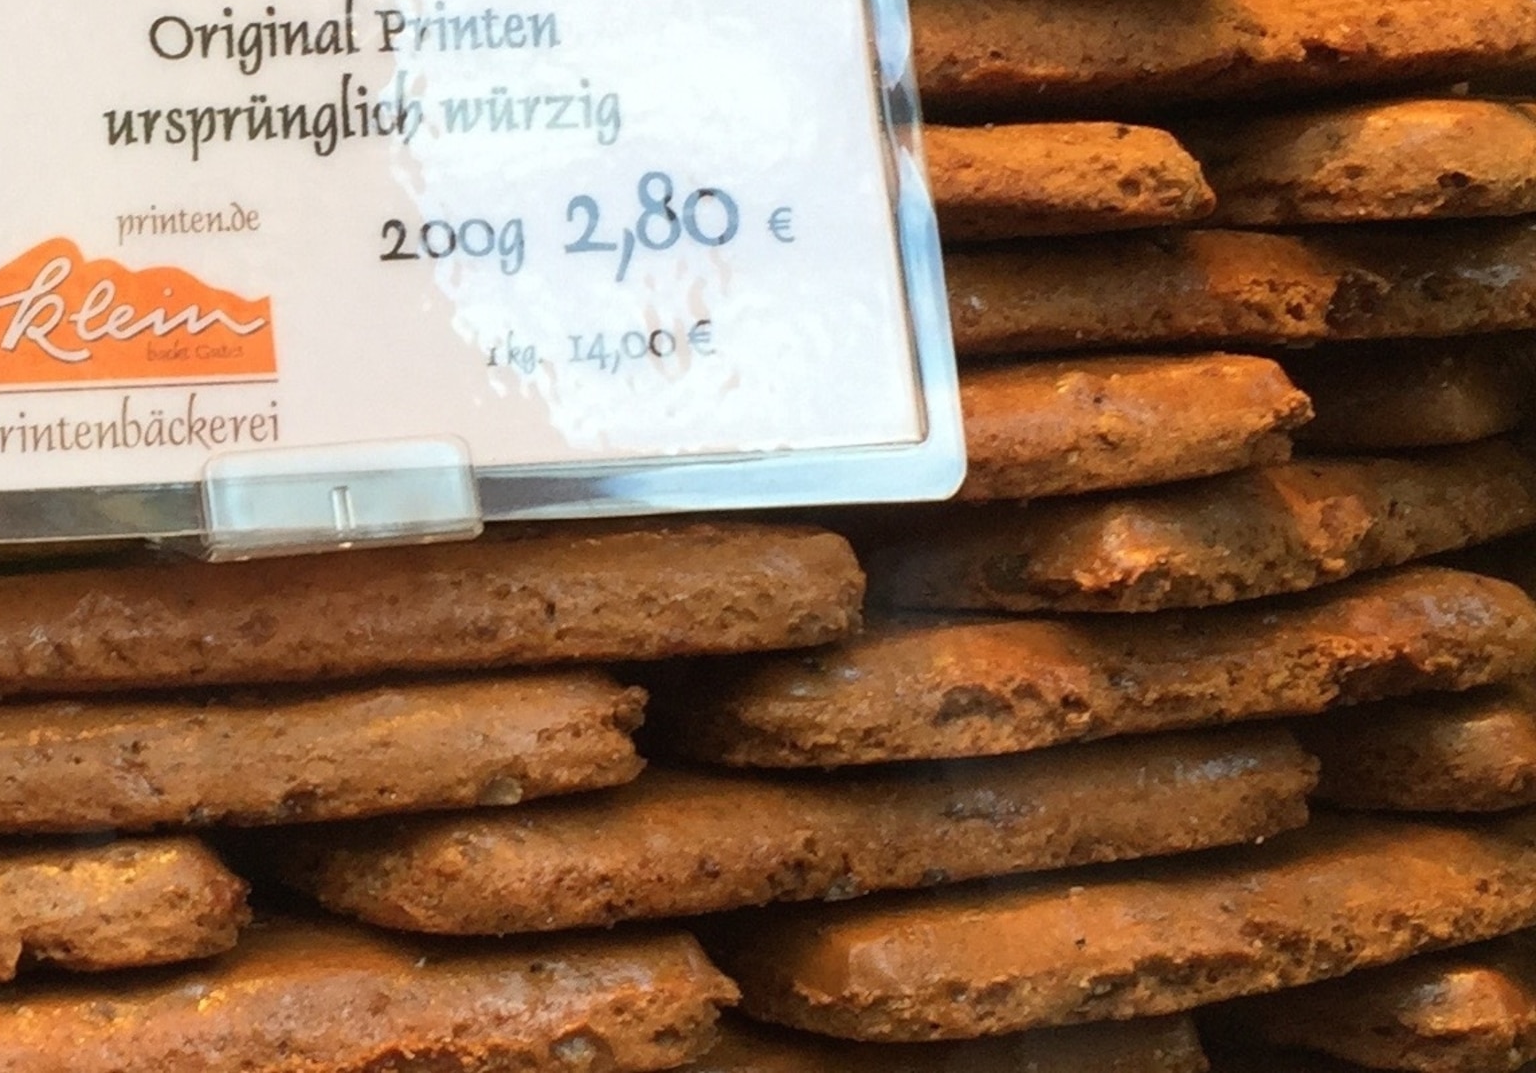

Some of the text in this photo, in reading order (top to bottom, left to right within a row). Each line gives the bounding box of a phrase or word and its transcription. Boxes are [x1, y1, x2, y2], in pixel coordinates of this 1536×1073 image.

[375, 1, 562, 54] Printen
[102, 73, 623, 161] ursprünglich würzig
[116, 201, 262, 246] printen.de
[379, 170, 796, 283] 200g 2,80 €
[567, 329, 677, 375] 14,00
[686, 319, 718, 356] €
